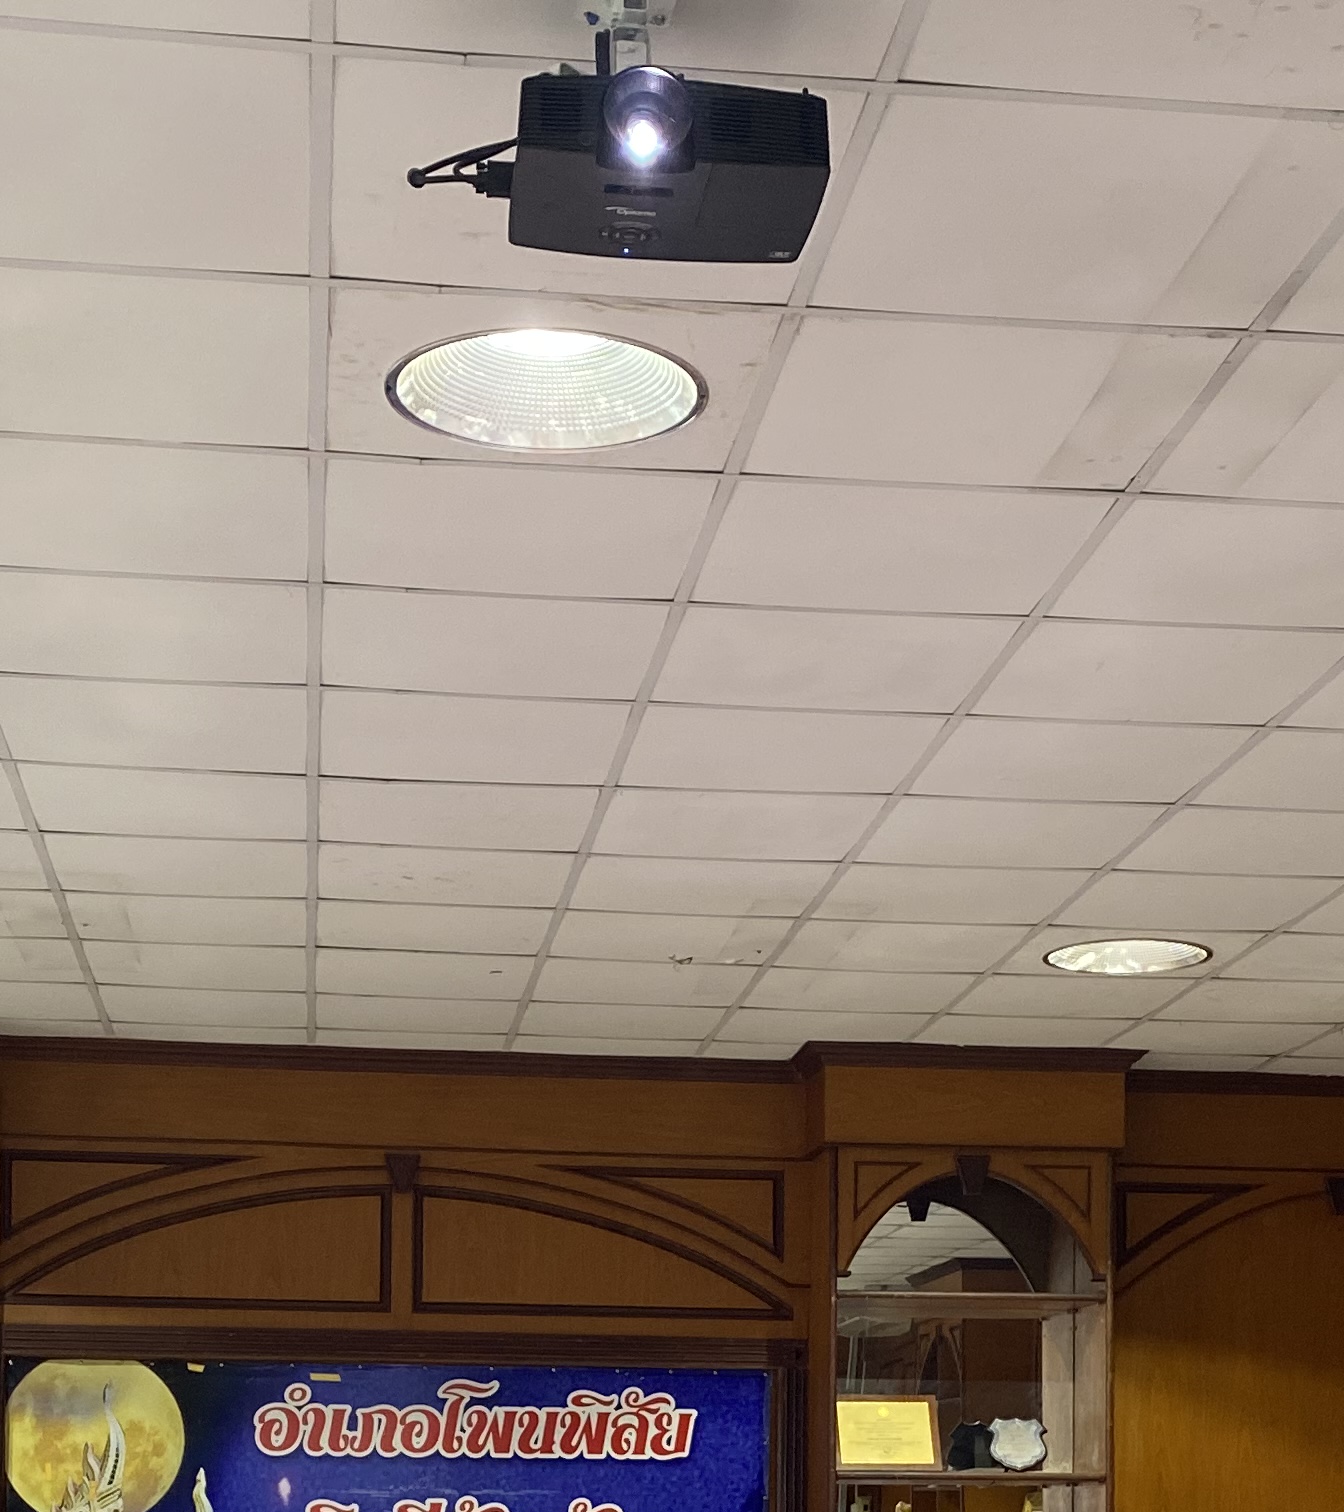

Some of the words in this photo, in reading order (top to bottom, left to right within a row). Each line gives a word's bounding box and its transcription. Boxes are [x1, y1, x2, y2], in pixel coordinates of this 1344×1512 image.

[255, 1380, 698, 1460] อำเภอโพนพิสัย
